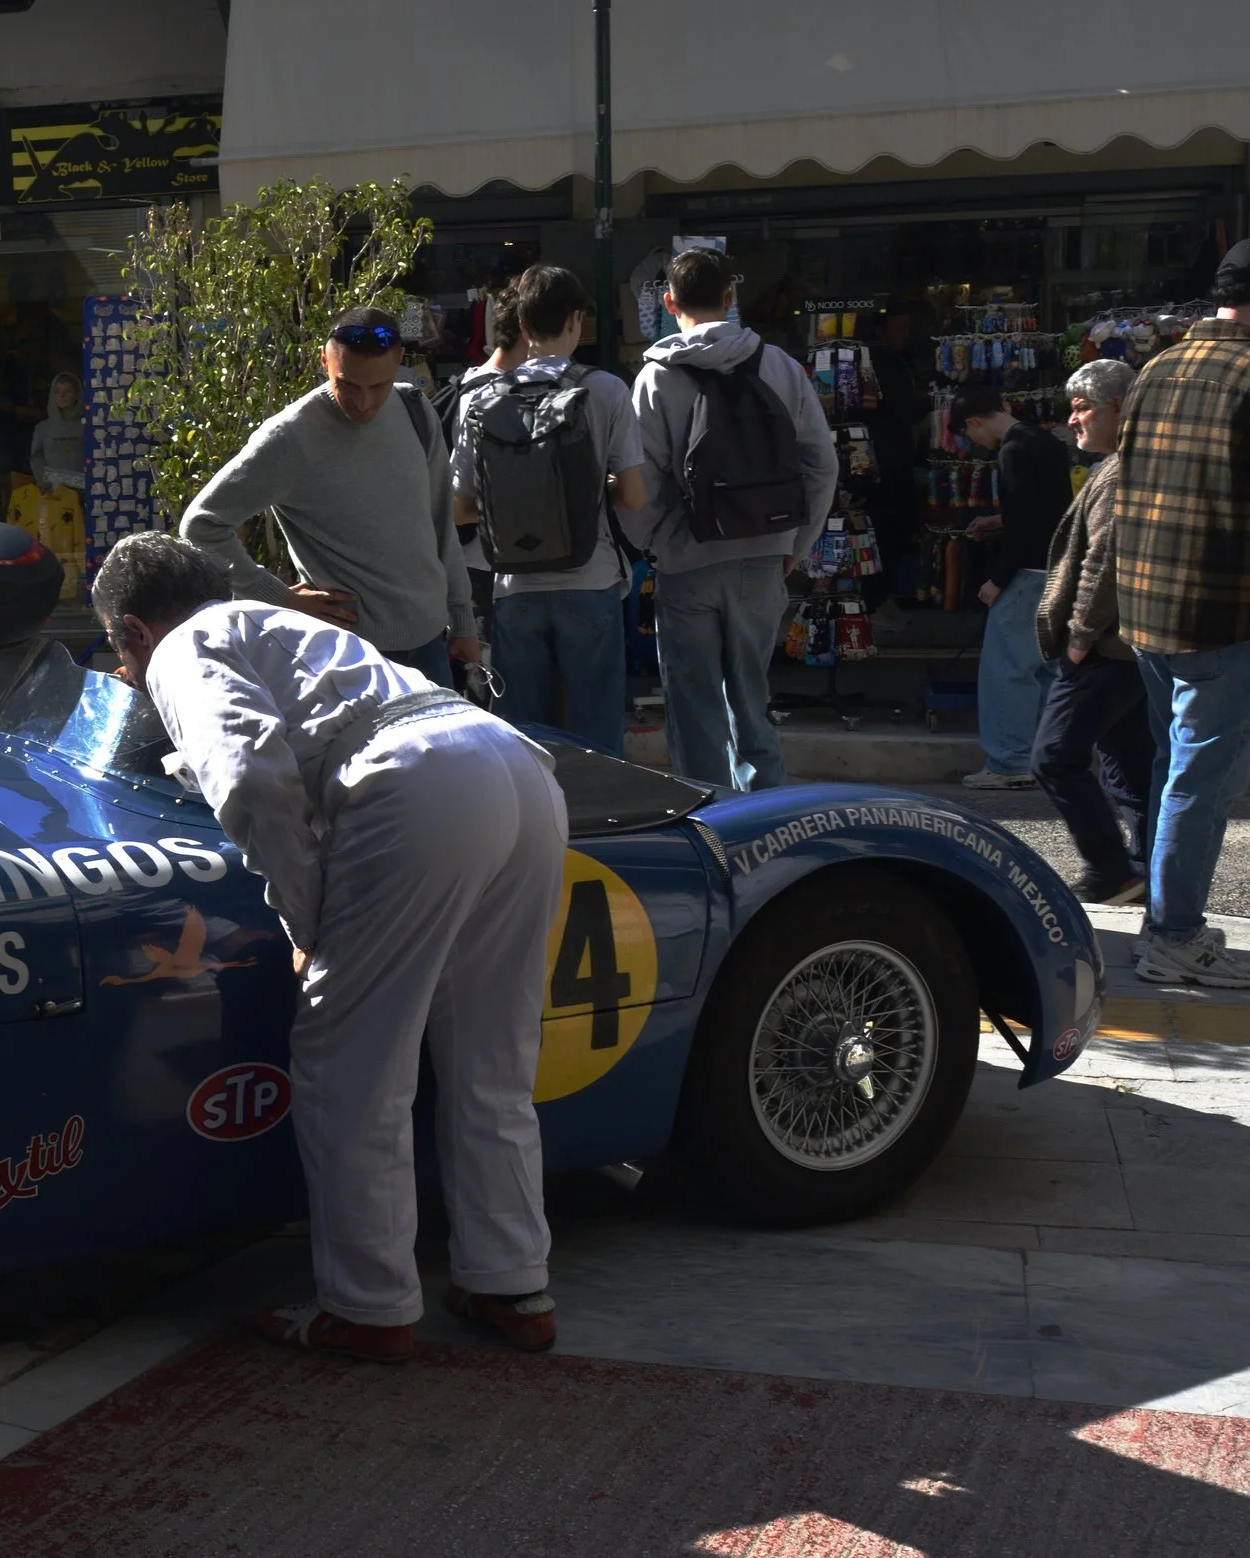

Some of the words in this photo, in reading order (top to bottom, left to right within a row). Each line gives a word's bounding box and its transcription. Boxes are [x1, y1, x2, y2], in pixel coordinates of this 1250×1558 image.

[51, 158, 93, 176] Black
[97, 160, 117, 174] &
[122, 157, 170, 174] Yellow
[170, 171, 209, 187] Store
[817, 301, 844, 309] NODO
[846, 300, 874, 308] SOCKS
[733, 849, 751, 876] V
[752, 811, 845, 864] CARRERA
[845, 807, 1004, 869] PANAMERICANA
[541, 879, 631, 1050] 4
[1056, 1032, 1078, 1057] STP
[202, 1071, 280, 1130] STP
